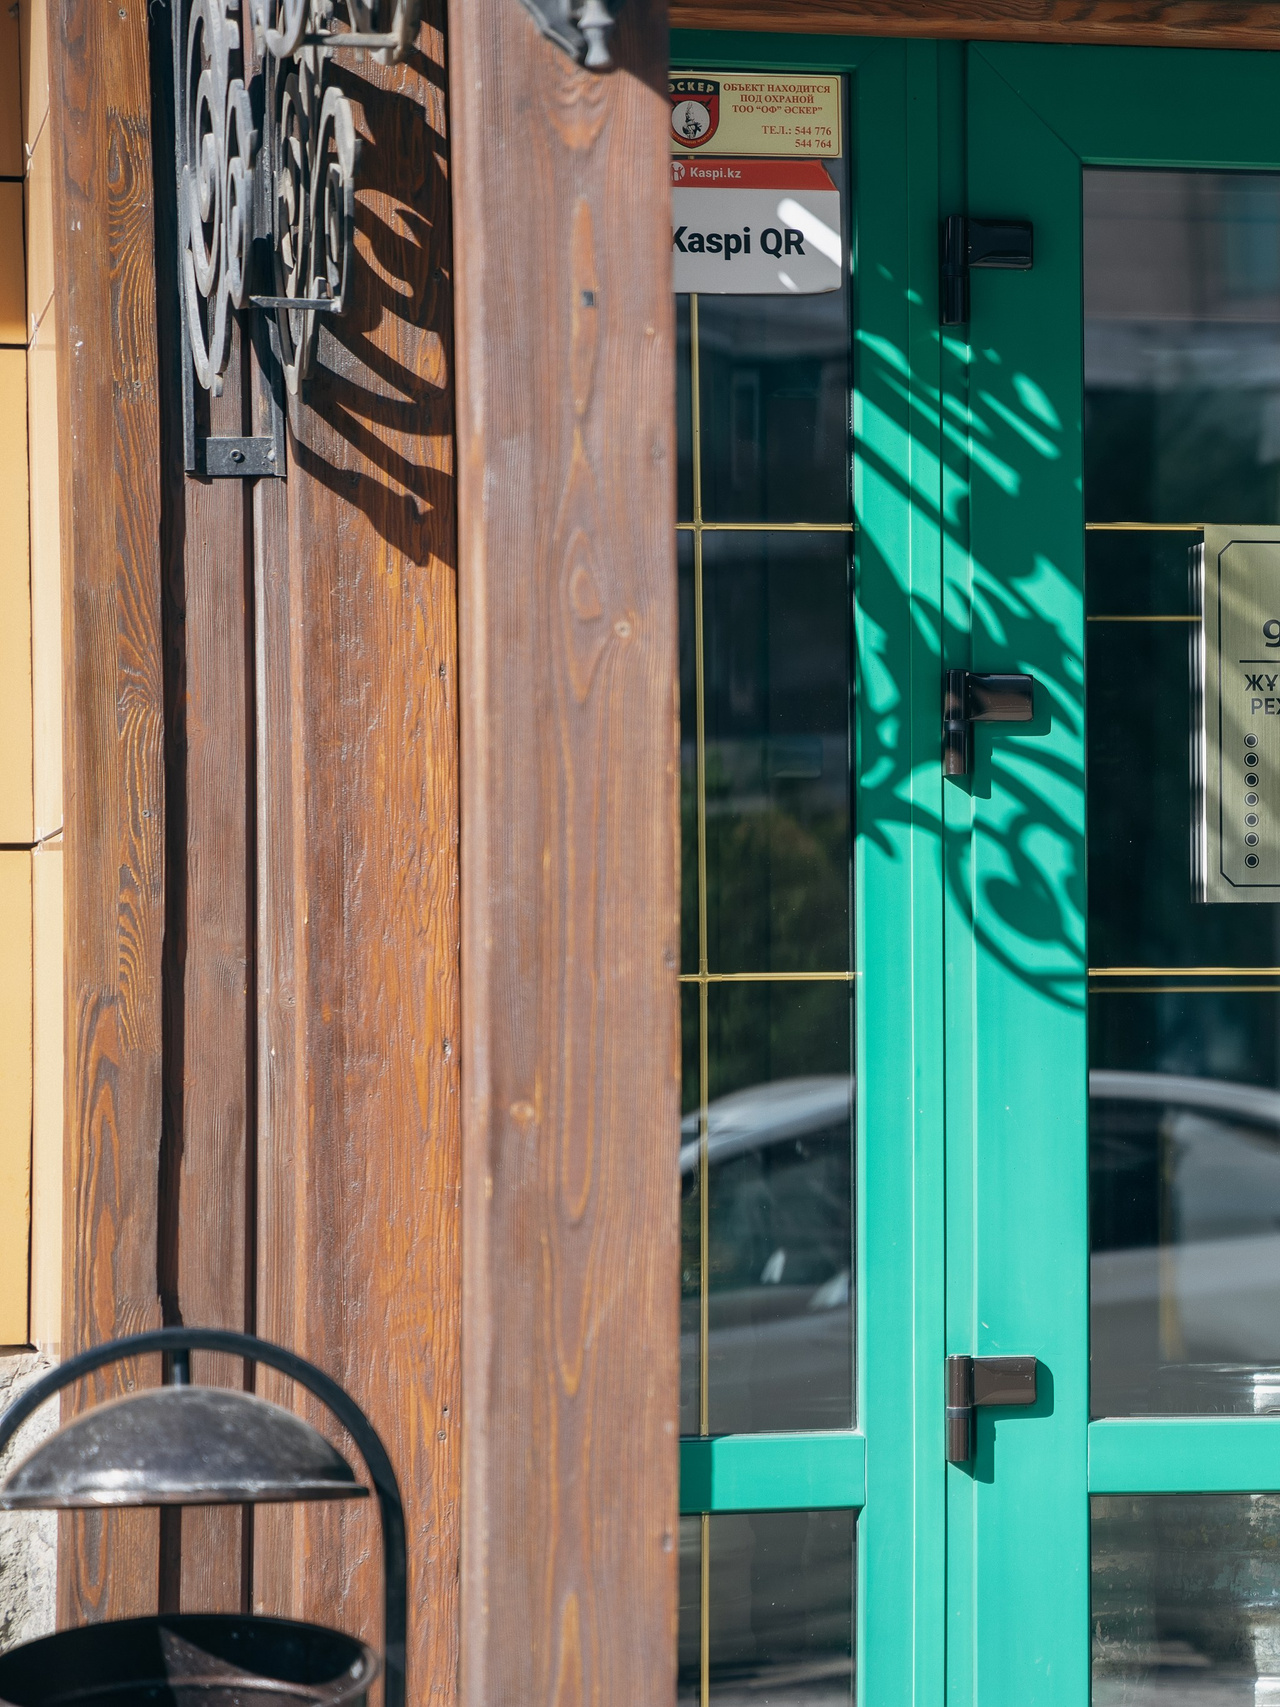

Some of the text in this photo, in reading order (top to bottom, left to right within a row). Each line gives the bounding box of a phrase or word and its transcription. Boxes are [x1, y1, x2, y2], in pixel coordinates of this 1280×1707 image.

[723, 83, 831, 94] ОБЪЕКТ НАХОДИТСЯ
[740, 94, 814, 104] ПОД ОХРАНОЙ
[732, 105, 754, 113] ТОО
[762, 125, 832, 136] ТЕЛ.: 544 776
[795, 139, 832, 148] 544 764
[690, 167, 741, 180] Kaspi.kz
[672, 226, 806, 261] Kaspi QR
